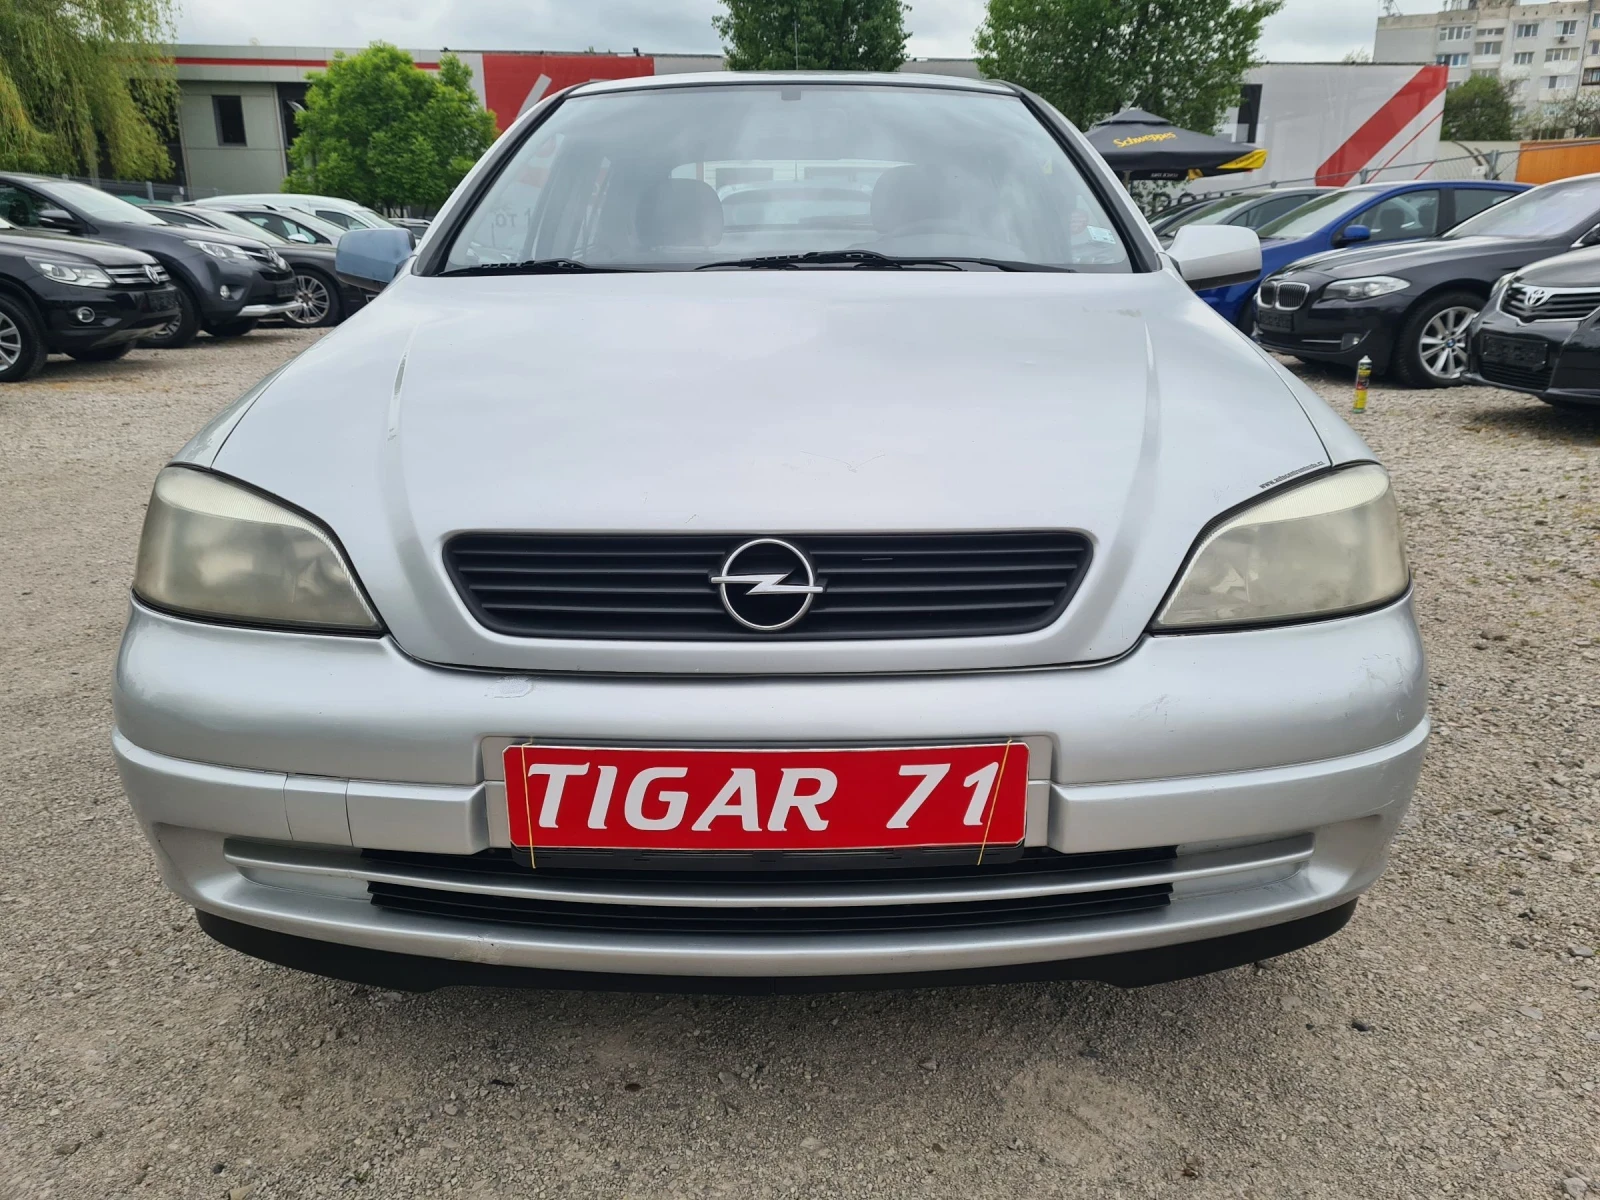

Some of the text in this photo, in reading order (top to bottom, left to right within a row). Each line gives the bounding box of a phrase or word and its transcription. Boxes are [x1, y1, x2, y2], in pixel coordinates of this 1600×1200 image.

[1113, 132, 1177, 148] Schweppes
[527, 761, 1000, 832] TIGAR 71
